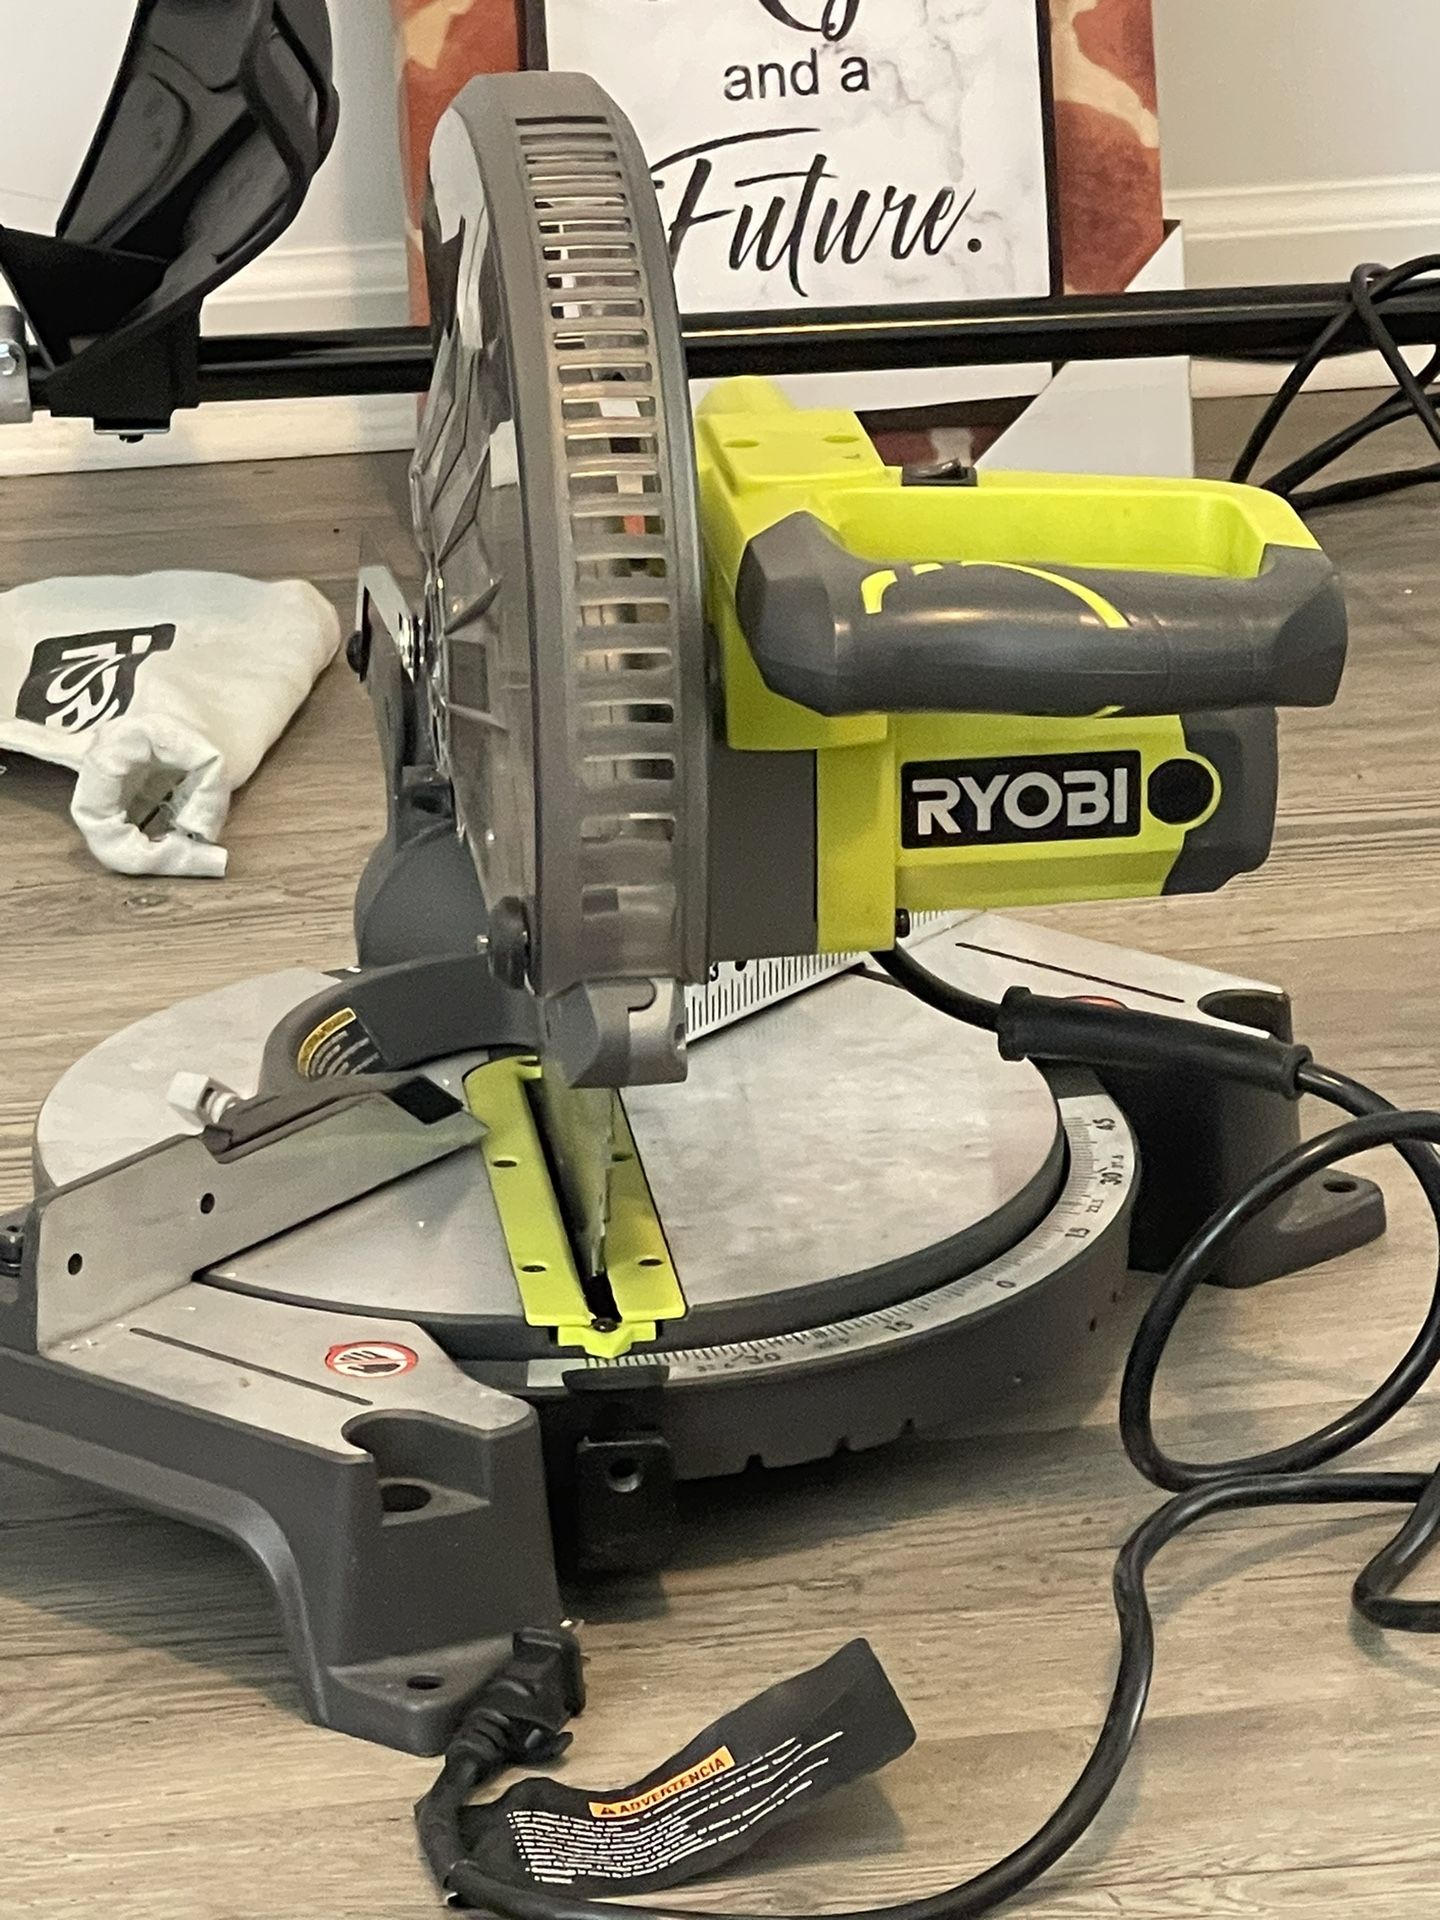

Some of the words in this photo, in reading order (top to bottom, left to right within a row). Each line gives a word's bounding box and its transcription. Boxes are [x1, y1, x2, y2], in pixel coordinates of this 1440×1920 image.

[724, 48, 820, 100] and
[841, 56, 870, 92] a
[651, 128, 982, 297] Future.
[912, 768, 1128, 835] RYOBI
[1065, 1227, 1090, 1238] 15
[996, 1280, 1017, 1289] 0
[620, 1757, 726, 1814] ADVERTENCIA
